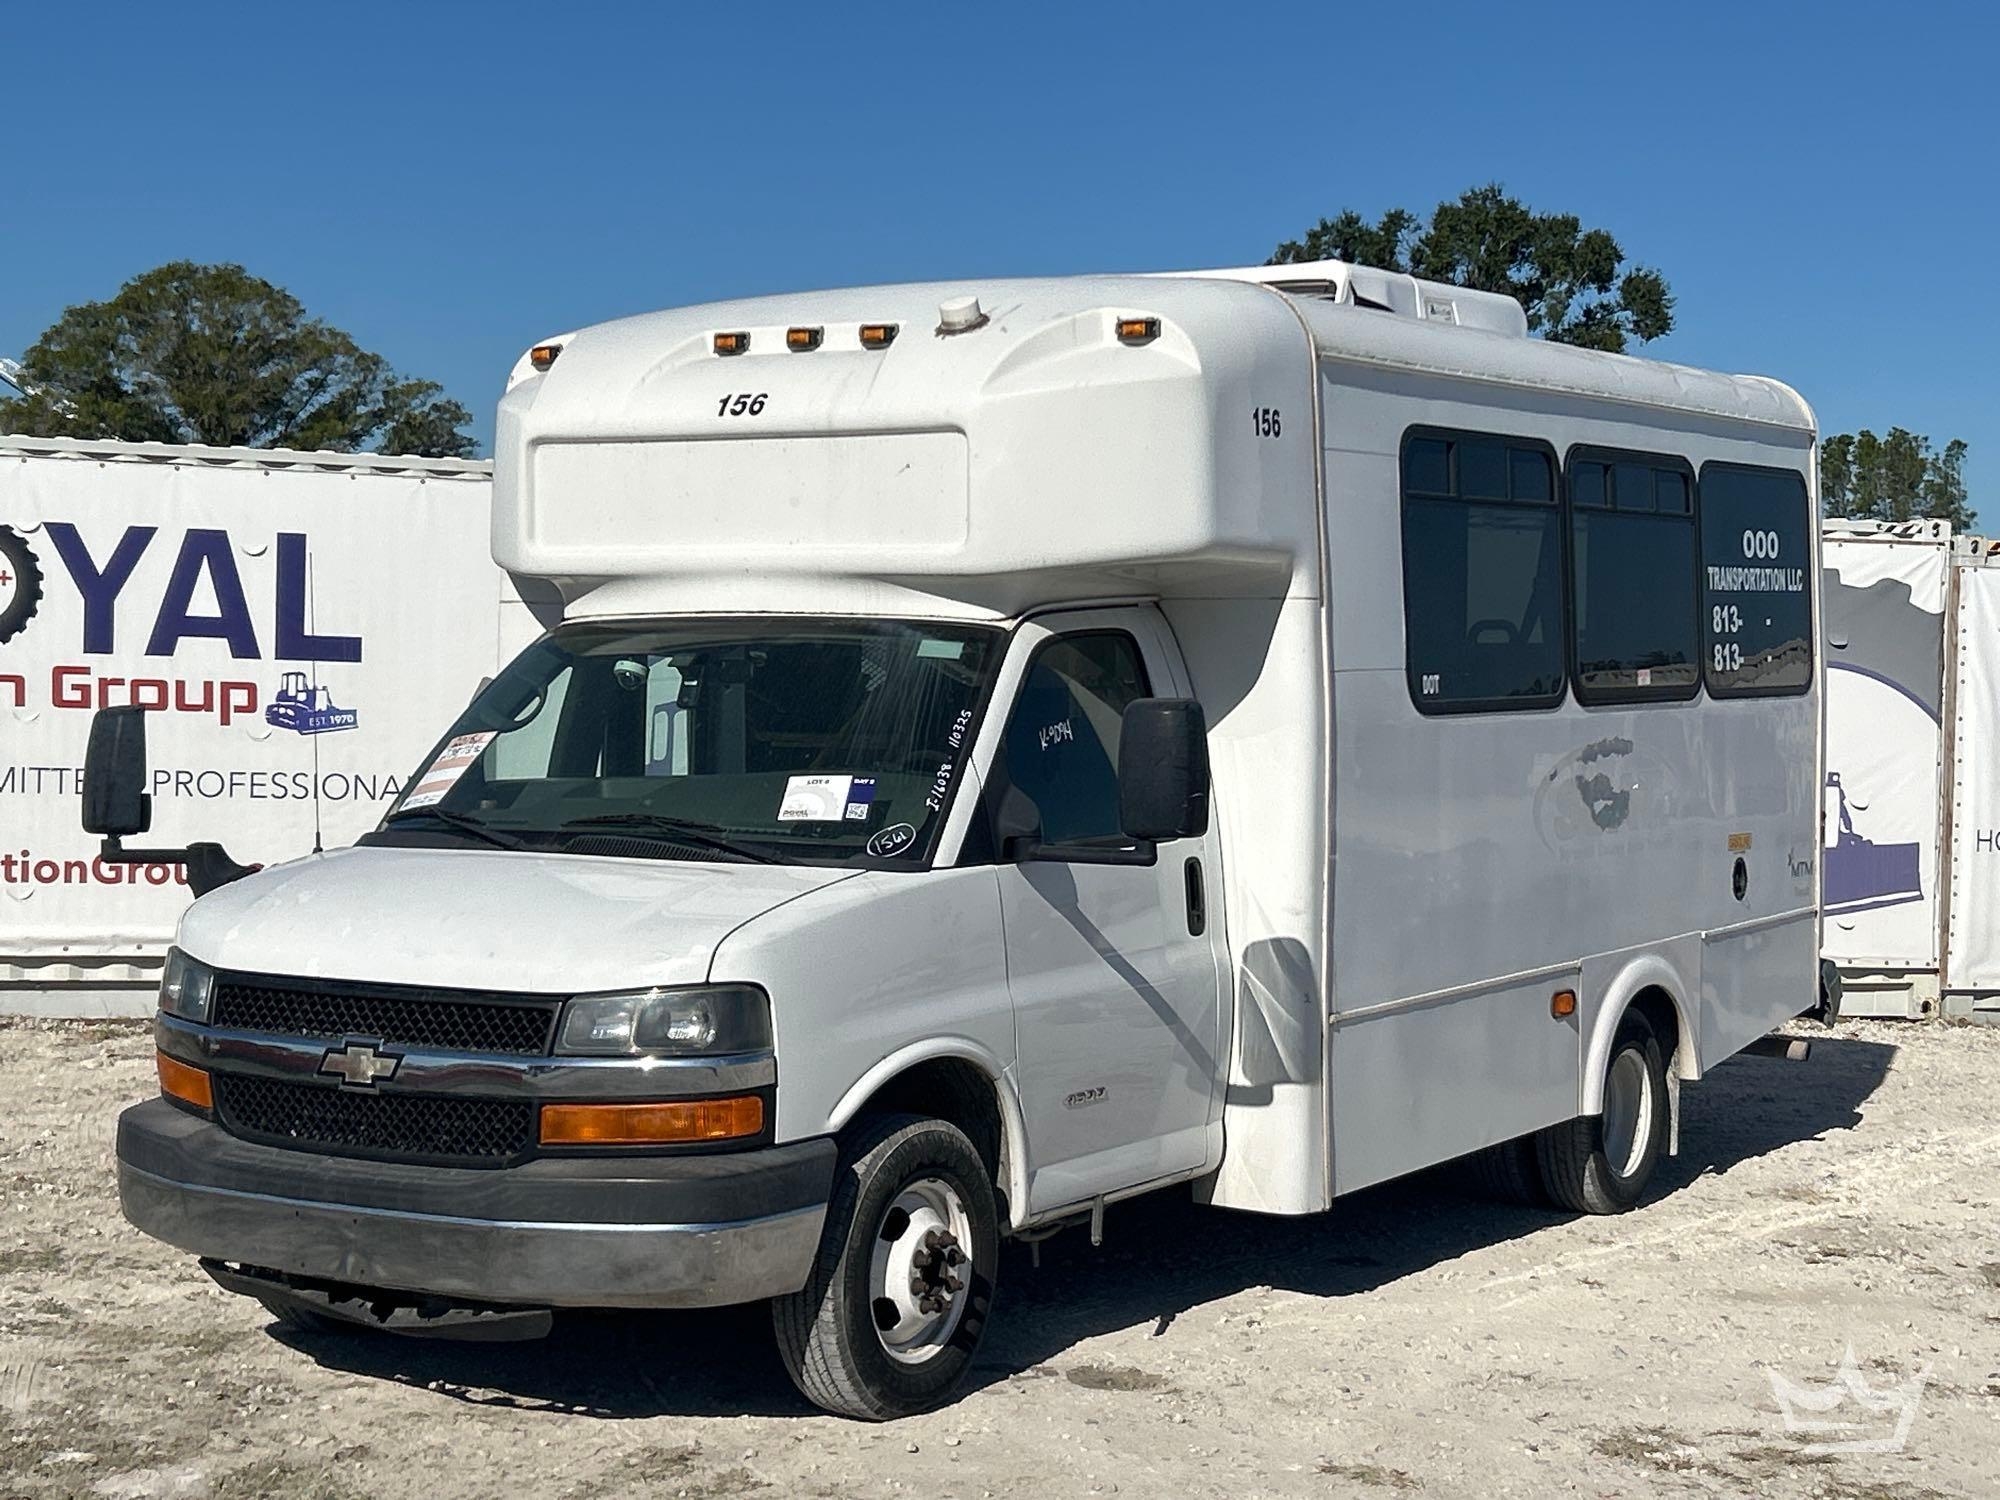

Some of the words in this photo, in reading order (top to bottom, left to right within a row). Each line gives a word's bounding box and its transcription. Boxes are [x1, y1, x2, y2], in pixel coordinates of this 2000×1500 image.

[718, 393, 768, 417] 156
[1253, 407, 1281, 438] 156
[1707, 566, 1786, 591] TRANSPORTATION
[1787, 568, 1803, 591] LLC
[52, 666, 257, 726] Group
[1422, 674, 1440, 694] DOT
[330, 714, 354, 725] 1970
[948, 709, 972, 749] 110325
[153, 769, 411, 801] PROFESSIONA
[1976, 829, 2000, 852] H
